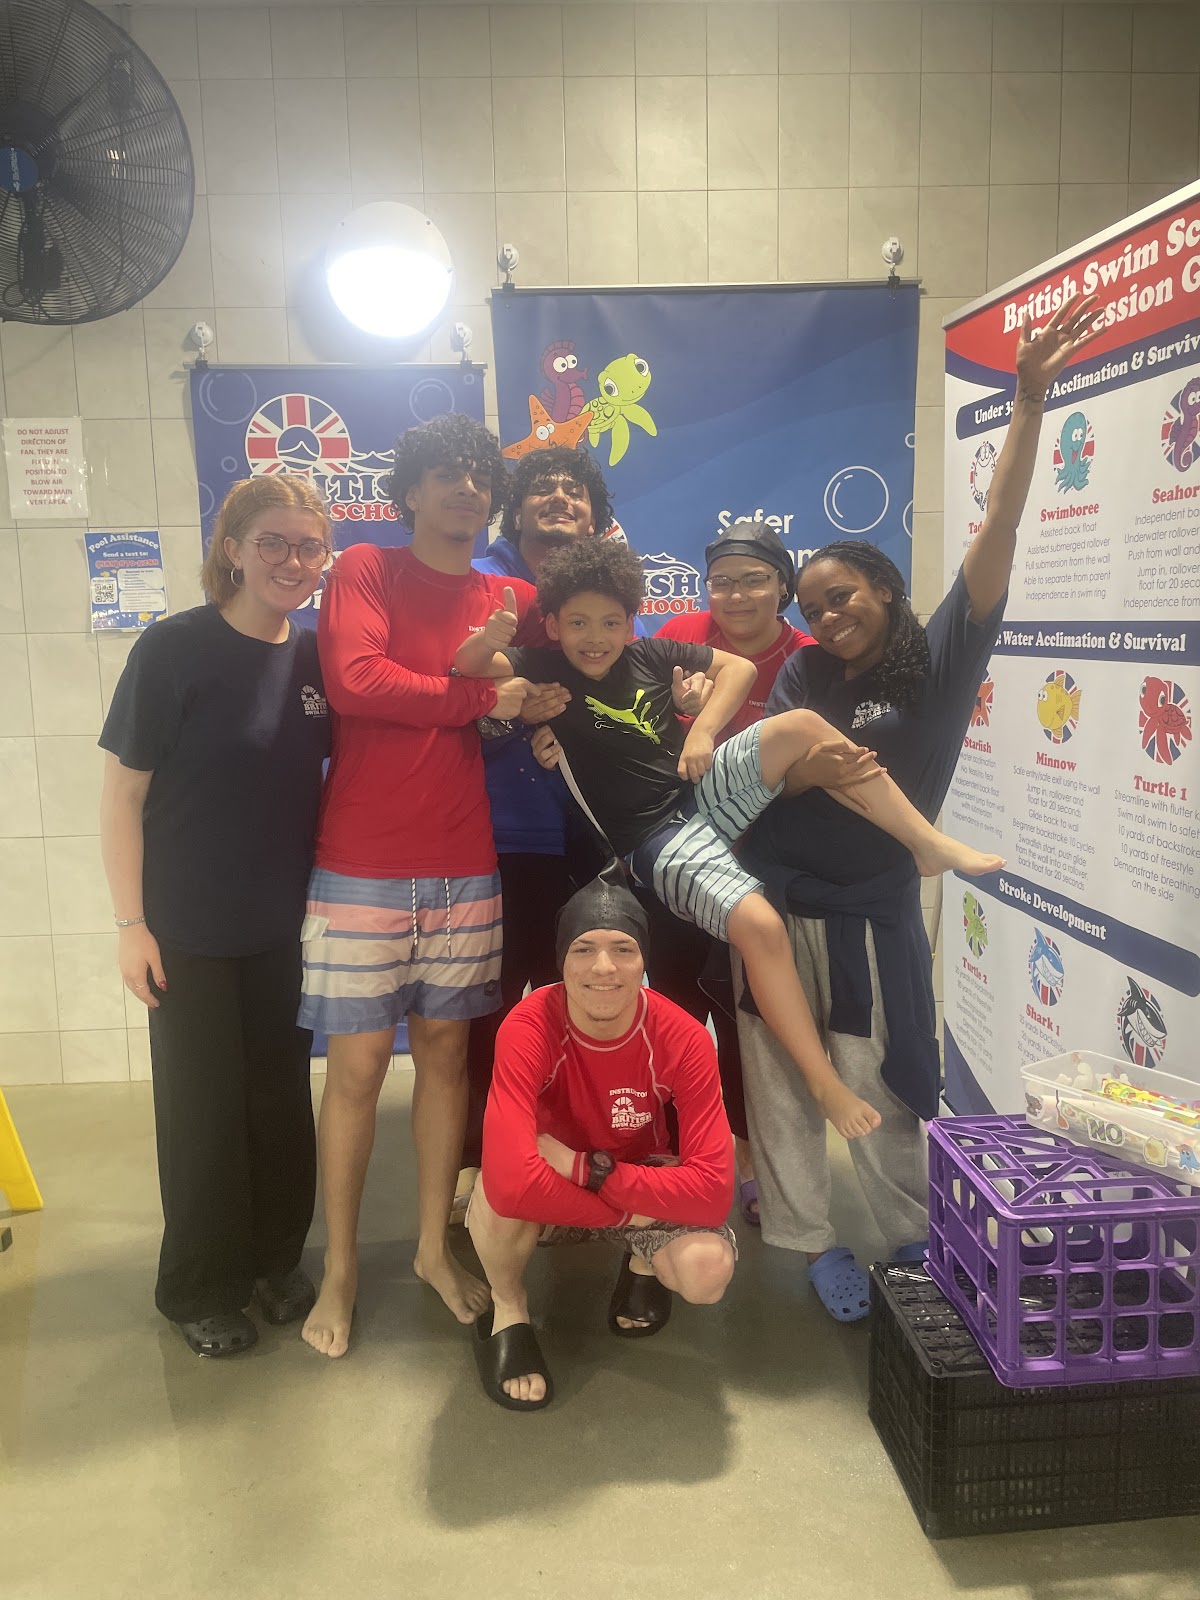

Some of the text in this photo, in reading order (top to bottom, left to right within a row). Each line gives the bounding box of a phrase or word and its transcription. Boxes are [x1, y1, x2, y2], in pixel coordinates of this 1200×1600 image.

[1003, 274, 1077, 334] British
[1082, 239, 1159, 296] Swim
[1051, 360, 1128, 399] Acclimation
[1131, 350, 1144, 371] &
[974, 404, 1004, 425] Under
[1040, 503, 1099, 522] Swimboree
[1135, 507, 1186, 526] Independent
[1040, 522, 1097, 538] Assisted back float
[1124, 530, 1168, 544] Underwater
[88, 536, 109, 553] Pool
[109, 532, 159, 550] Assistance
[1027, 538, 1110, 555] Assisted submerged rollover
[1128, 543, 1200, 561] Push from wall and
[1025, 553, 1111, 570] Full submersion from the wall
[1137, 566, 1157, 578] Jump
[1024, 570, 1111, 586] Able to separate from parent
[1139, 579, 1155, 591] float
[1156, 578, 1168, 590] for
[1168, 577, 1179, 589] 20
[1025, 588, 1106, 602] Independence in swim ring
[1123, 597, 1179, 610] Independence
[1002, 630, 1034, 647] Water
[1035, 631, 1106, 649] Acclimation
[1108, 631, 1122, 649] &
[1123, 632, 1187, 652] Survival
[1036, 751, 1077, 772] Minnow
[1013, 765, 1026, 776] Safe
[1052, 775, 1062, 785] exit
[1063, 778, 1078, 791] using
[1078, 781, 1087, 792] the
[1088, 785, 1101, 795] wall
[1133, 774, 1187, 801] Turtle 1
[1026, 783, 1041, 796] Jump
[1049, 789, 1072, 802] rollover
[1072, 796, 1084, 807] and
[1027, 794, 1082, 818] float for 20 seconds
[1114, 789, 1194, 819] Streamline with flutter
[1029, 808, 1080, 833] Glide back to wall
[1117, 807, 1134, 821] Swim
[1134, 813, 1146, 825] roll
[1147, 818, 1167, 831] swim
[1169, 822, 1178, 833] to
[1012, 817, 1036, 833] Beginner
[1036, 825, 1068, 844] backstroke
[1069, 836, 1076, 847] 10
[1076, 841, 1095, 855] cycles
[1118, 824, 1200, 859] 10 yards of backstroke
[1015, 843, 1028, 855] from
[1028, 848, 1037, 858] the
[1037, 854, 1049, 864] wall
[1049, 856, 1062, 869] into
[1058, 849, 1072, 861] push
[1073, 854, 1087, 867] glide
[1121, 842, 1194, 876] 10 yards of freestyle
[1018, 855, 1085, 891] back float for 20 seconds
[1113, 857, 1200, 899] Demonstrate breathing
[1131, 879, 1175, 902] on the side
[998, 877, 1107, 940] Stroke Development
[962, 956, 982, 981] Turtle
[982, 974, 988, 985] 2
[1025, 1021, 1039, 1036] yards
[1026, 1003, 1060, 1037] Shark 1
[1088, 1119, 1124, 1145] NO
